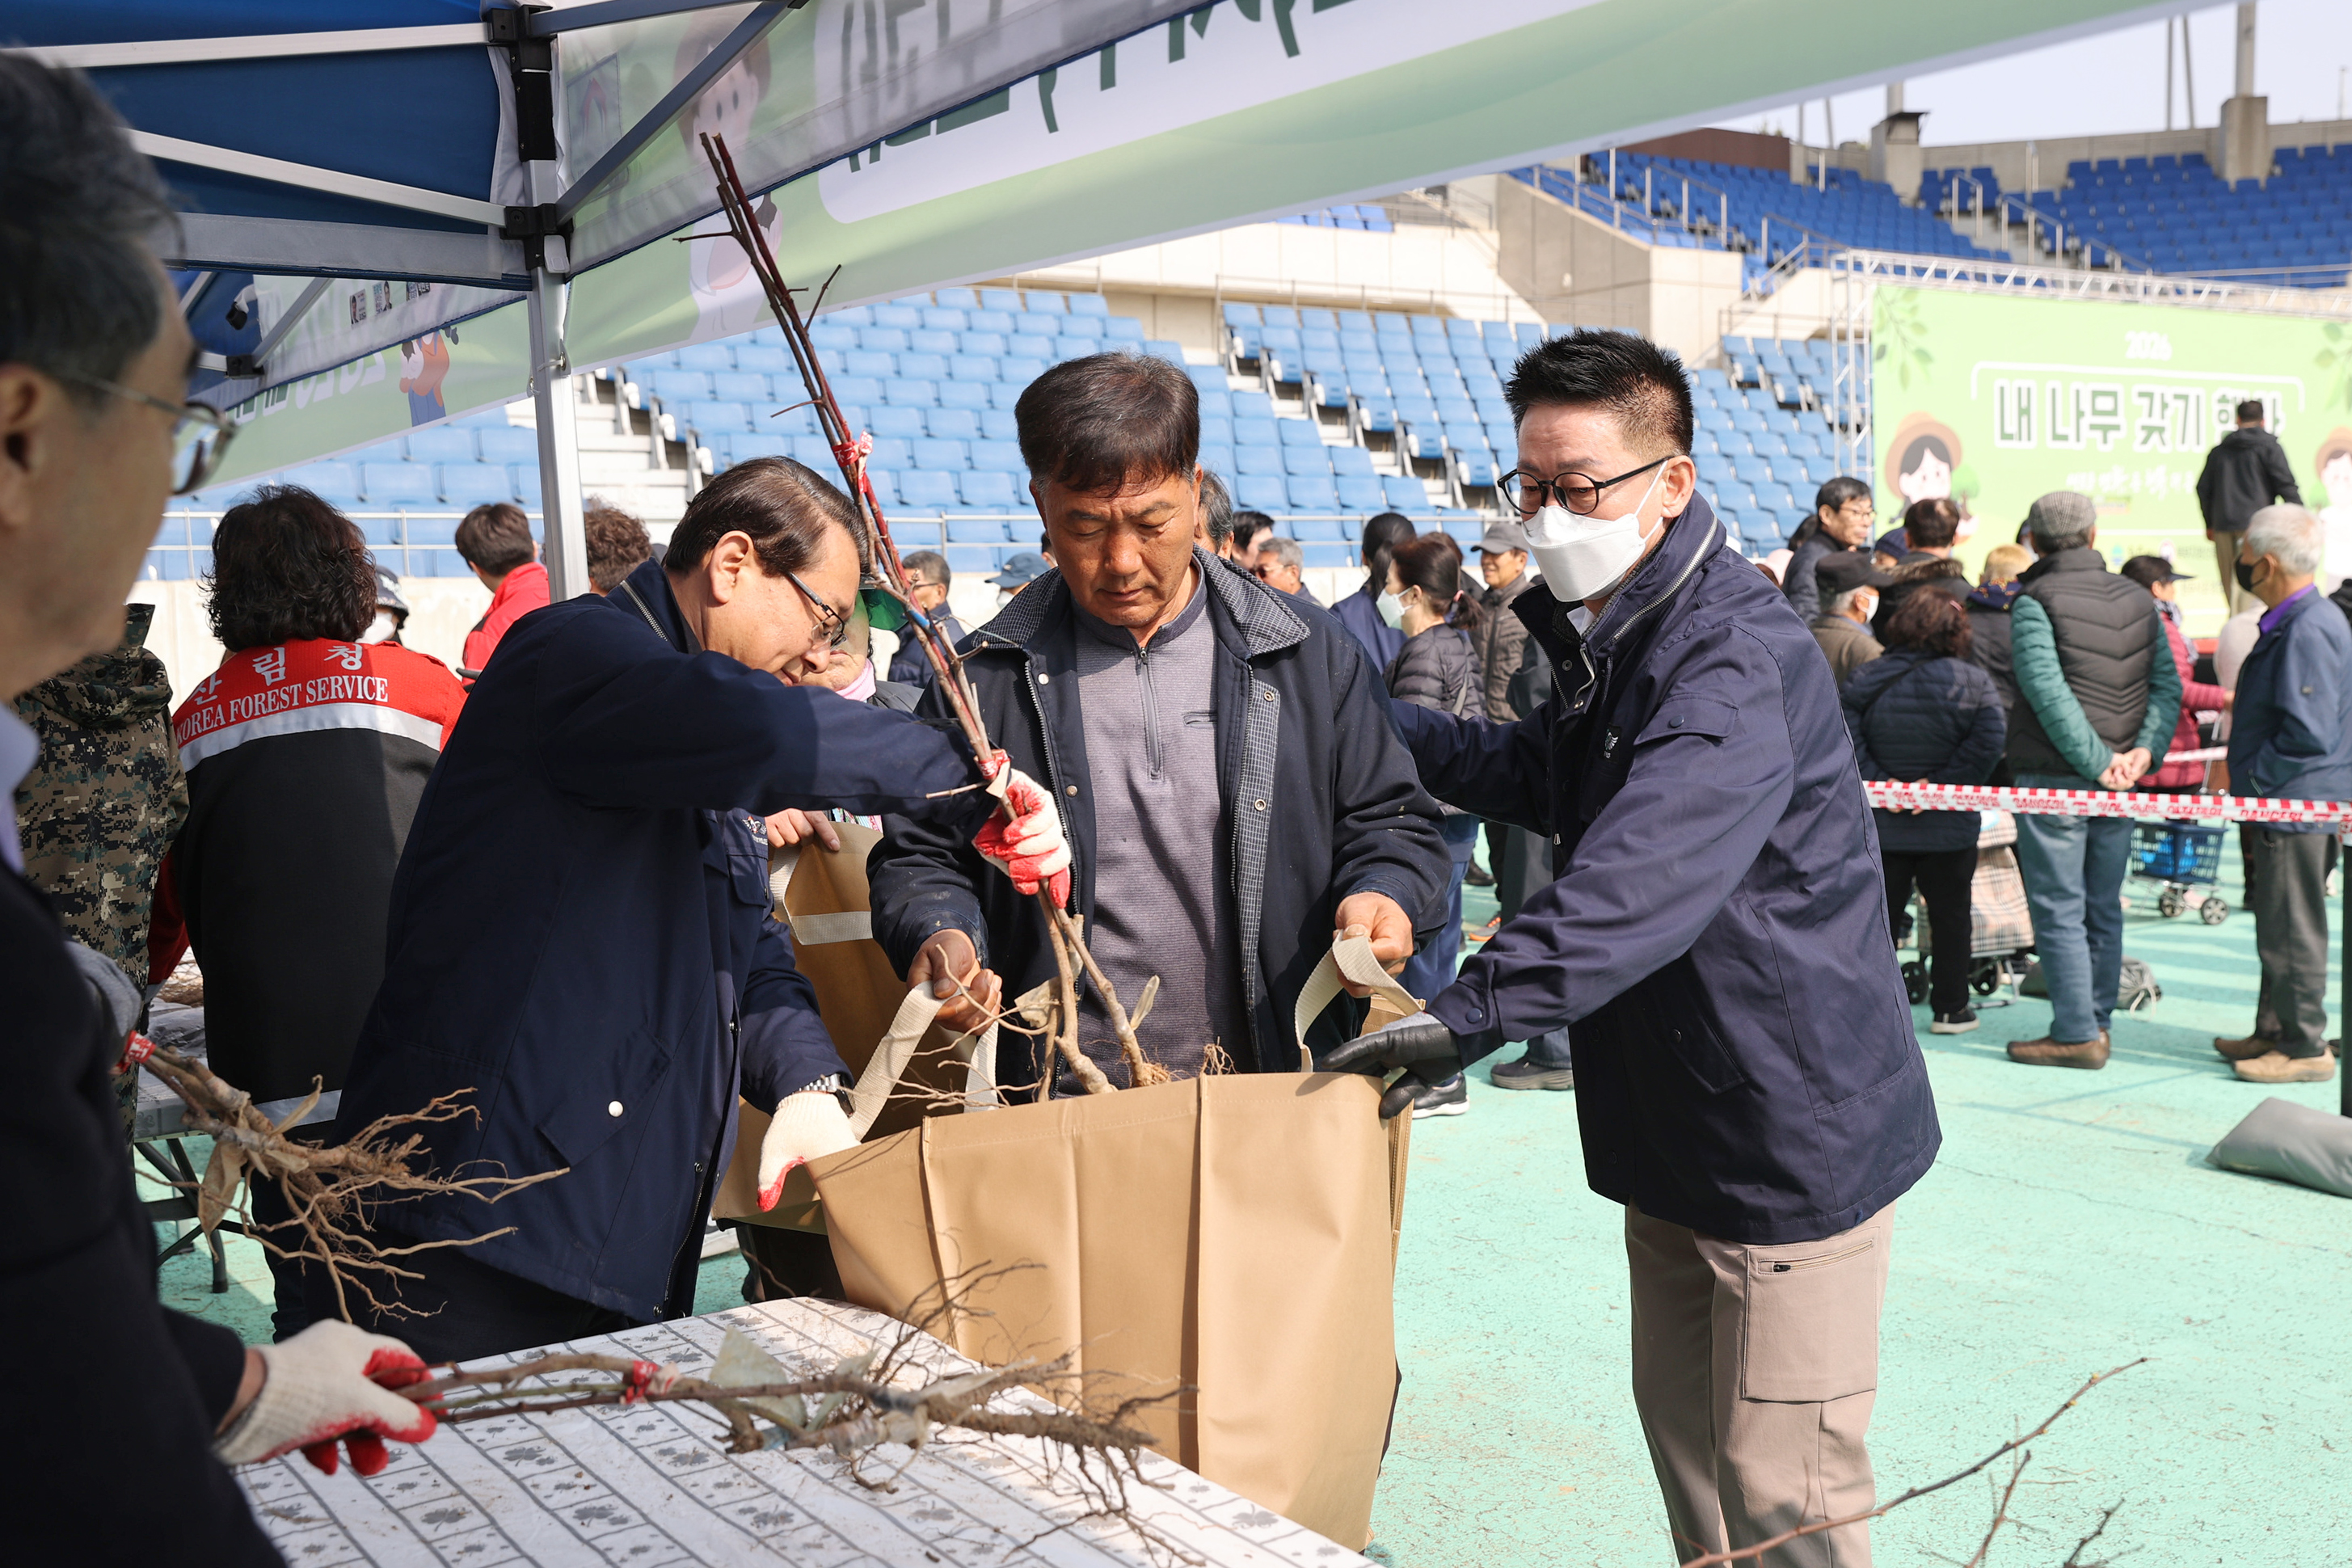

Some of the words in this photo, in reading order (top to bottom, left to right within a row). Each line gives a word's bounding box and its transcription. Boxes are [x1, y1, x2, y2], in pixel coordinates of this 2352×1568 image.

[2124, 330, 2173, 362] 2026
[1998, 383, 2034, 445] 내
[2048, 385, 2123, 447] 나무
[2134, 388, 2203, 449] 갖기
[175, 703, 226, 746] KOREA
[229, 683, 302, 723] FOREST
[306, 675, 389, 704] SERVICE
